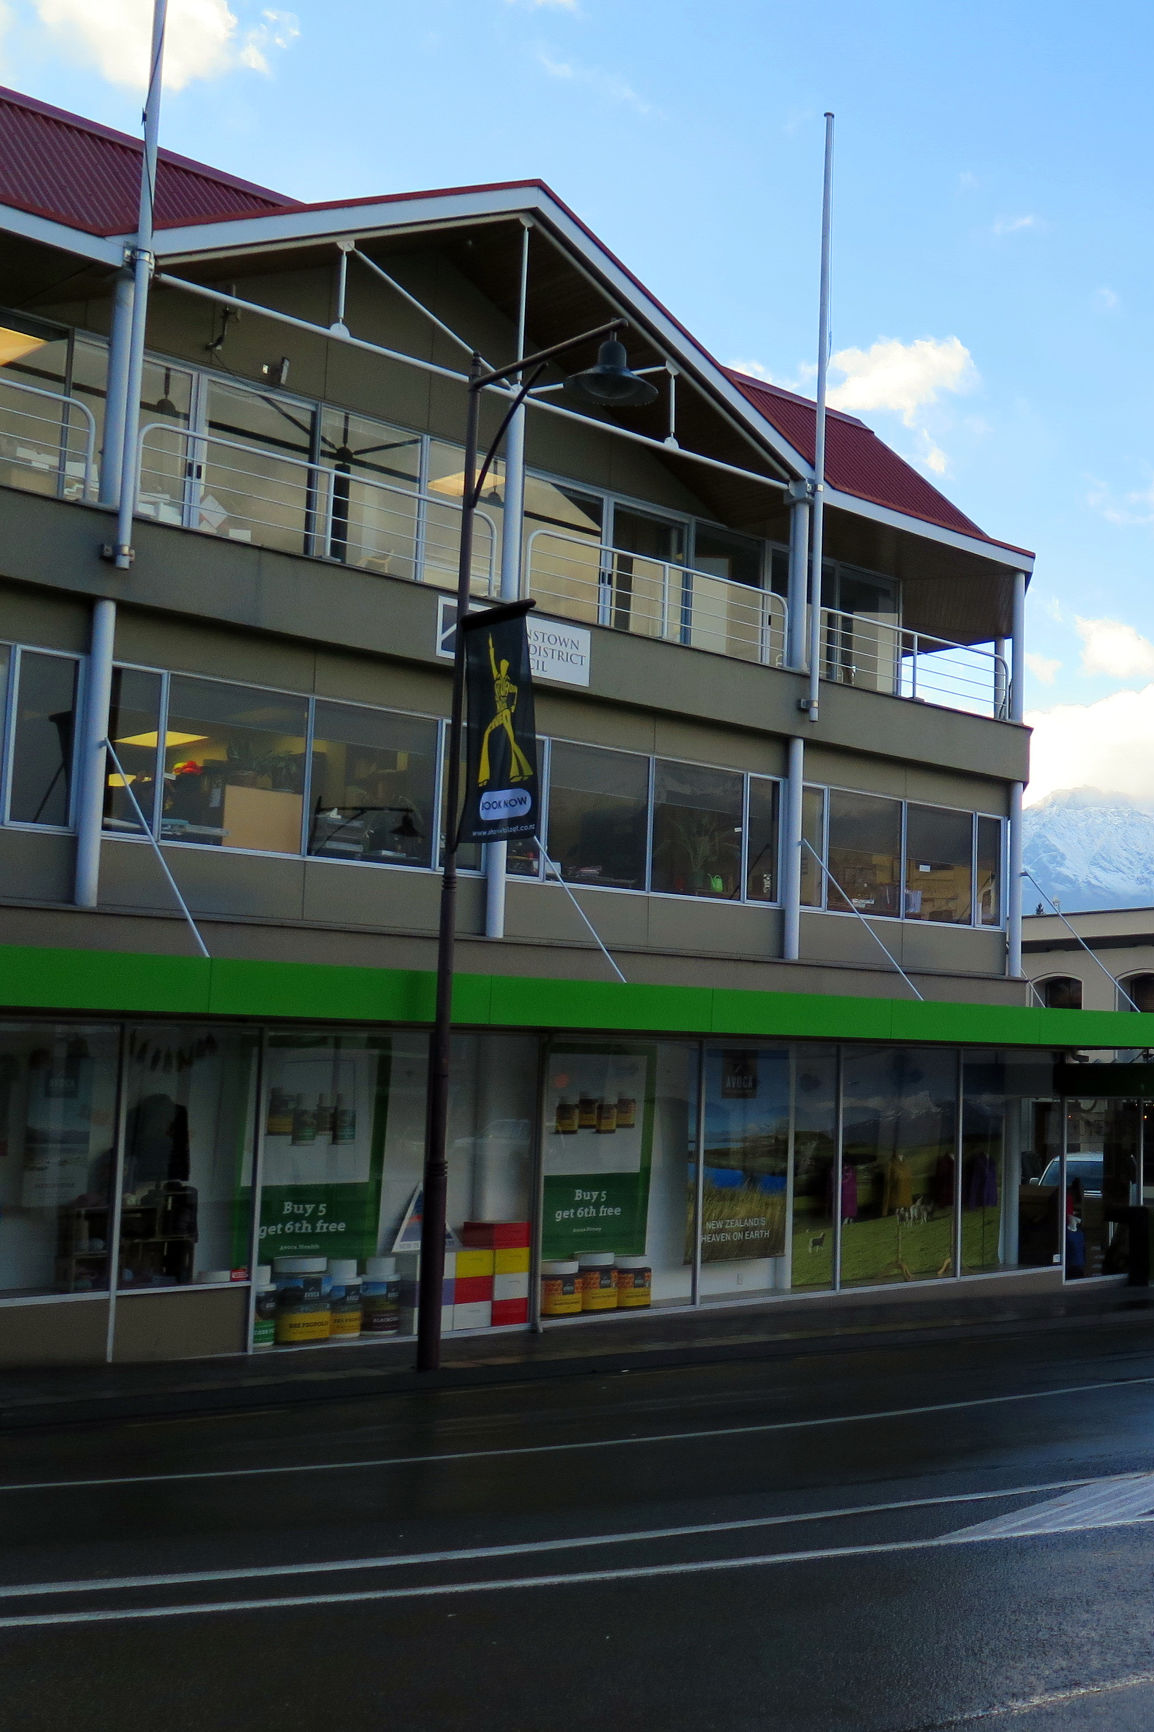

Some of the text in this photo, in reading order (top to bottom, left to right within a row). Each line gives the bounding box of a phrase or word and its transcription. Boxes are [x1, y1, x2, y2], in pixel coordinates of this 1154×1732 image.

[527, 629, 580, 650] NSTOWN
[528, 644, 586, 666] DISTRICT
[504, 796, 527, 808] NOW
[574, 1189, 608, 1202] Buy 5
[282, 1202, 328, 1217] Buy 5
[555, 1204, 622, 1222] get 6th free
[259, 1219, 347, 1239] get 6th free
[706, 1221, 724, 1229] NEW
[701, 1229, 770, 1243] HEAVEN ON EARTH
